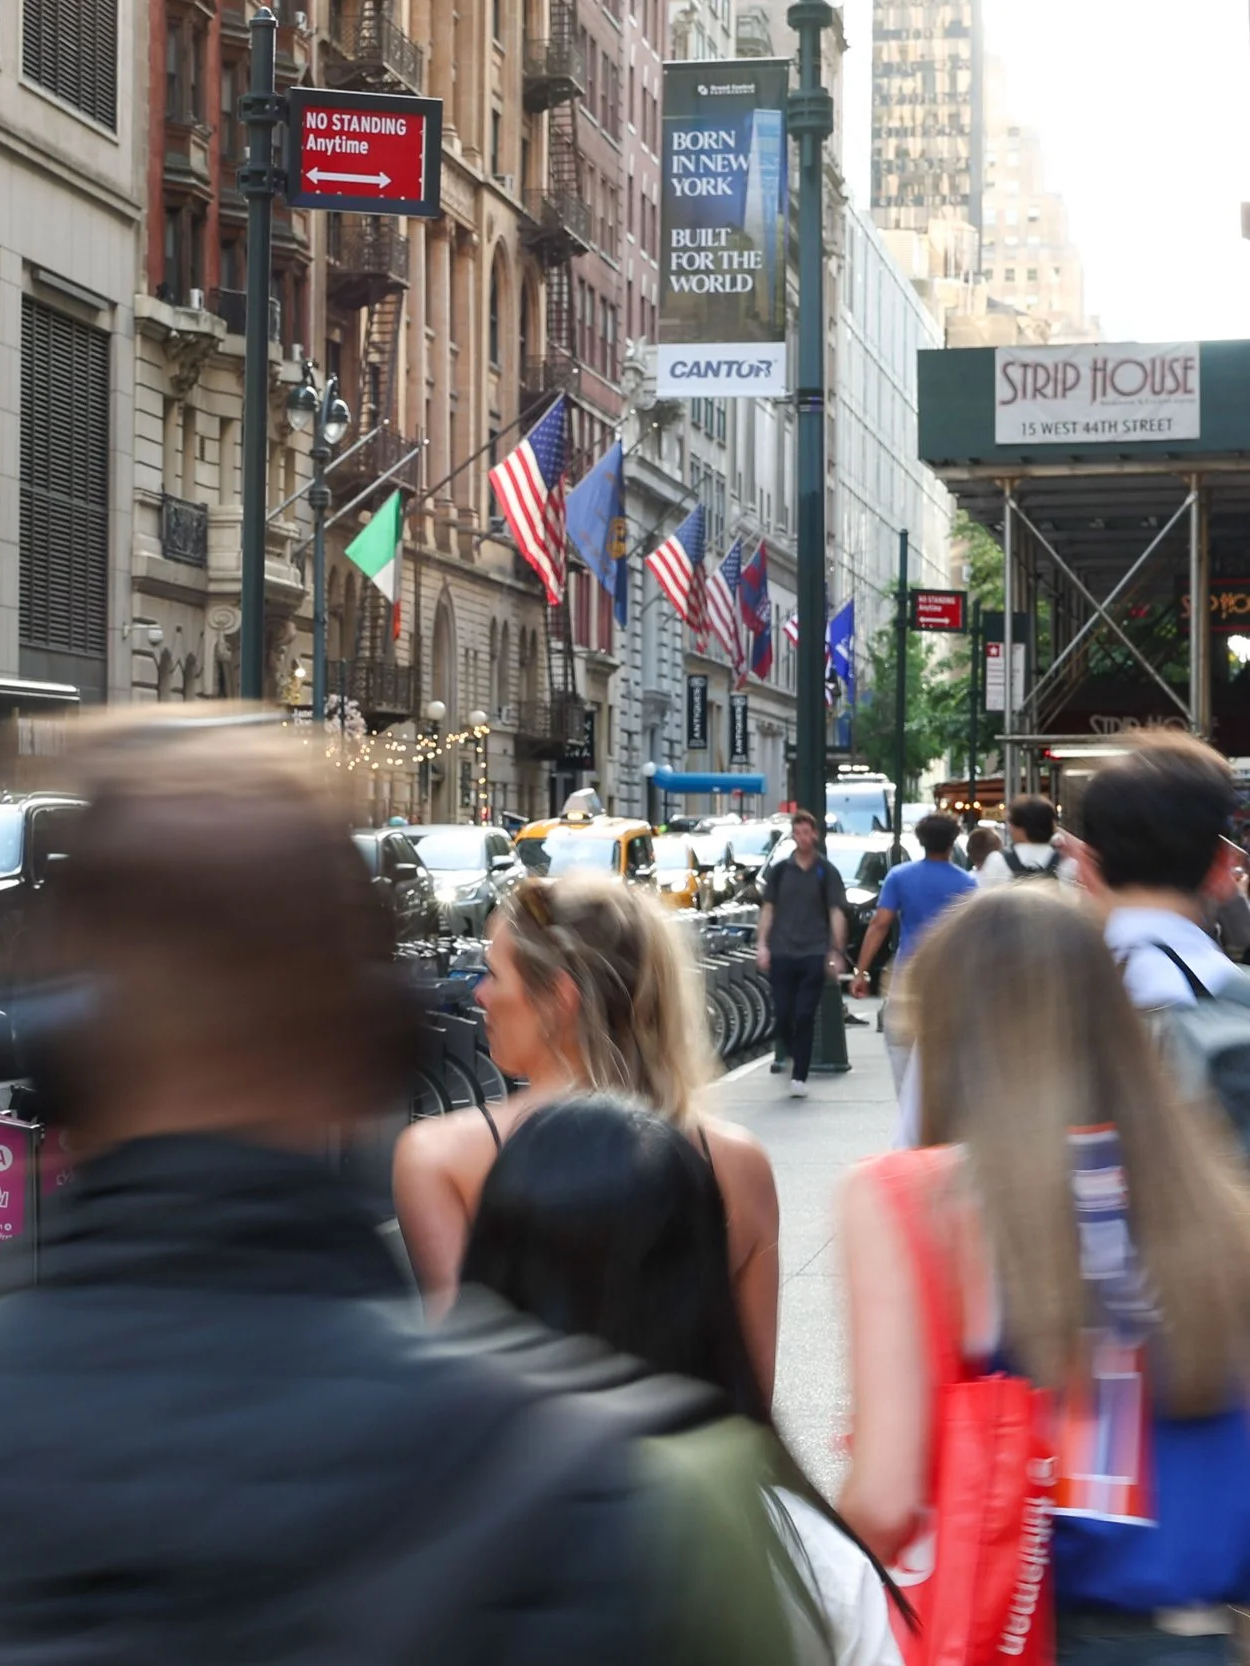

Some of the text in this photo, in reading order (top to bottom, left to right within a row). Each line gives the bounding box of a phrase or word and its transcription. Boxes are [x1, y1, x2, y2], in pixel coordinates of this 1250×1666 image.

[306, 112, 407, 136] NO STANDING
[306, 134, 369, 156] Anytime
[671, 130, 736, 151] BORN
[672, 153, 751, 173] IN NEW
[671, 176, 733, 197] YORK
[670, 227, 732, 248] BUILT
[670, 250, 763, 271] FOR THE
[669, 274, 754, 294] WORLD
[669, 359, 773, 379] CANTOR
[998, 356, 1196, 406] STRIP HOUSE
[1022, 418, 1173, 436] 15 WEST 44TH STREET
[693, 686, 702, 739] ANTIQUES
